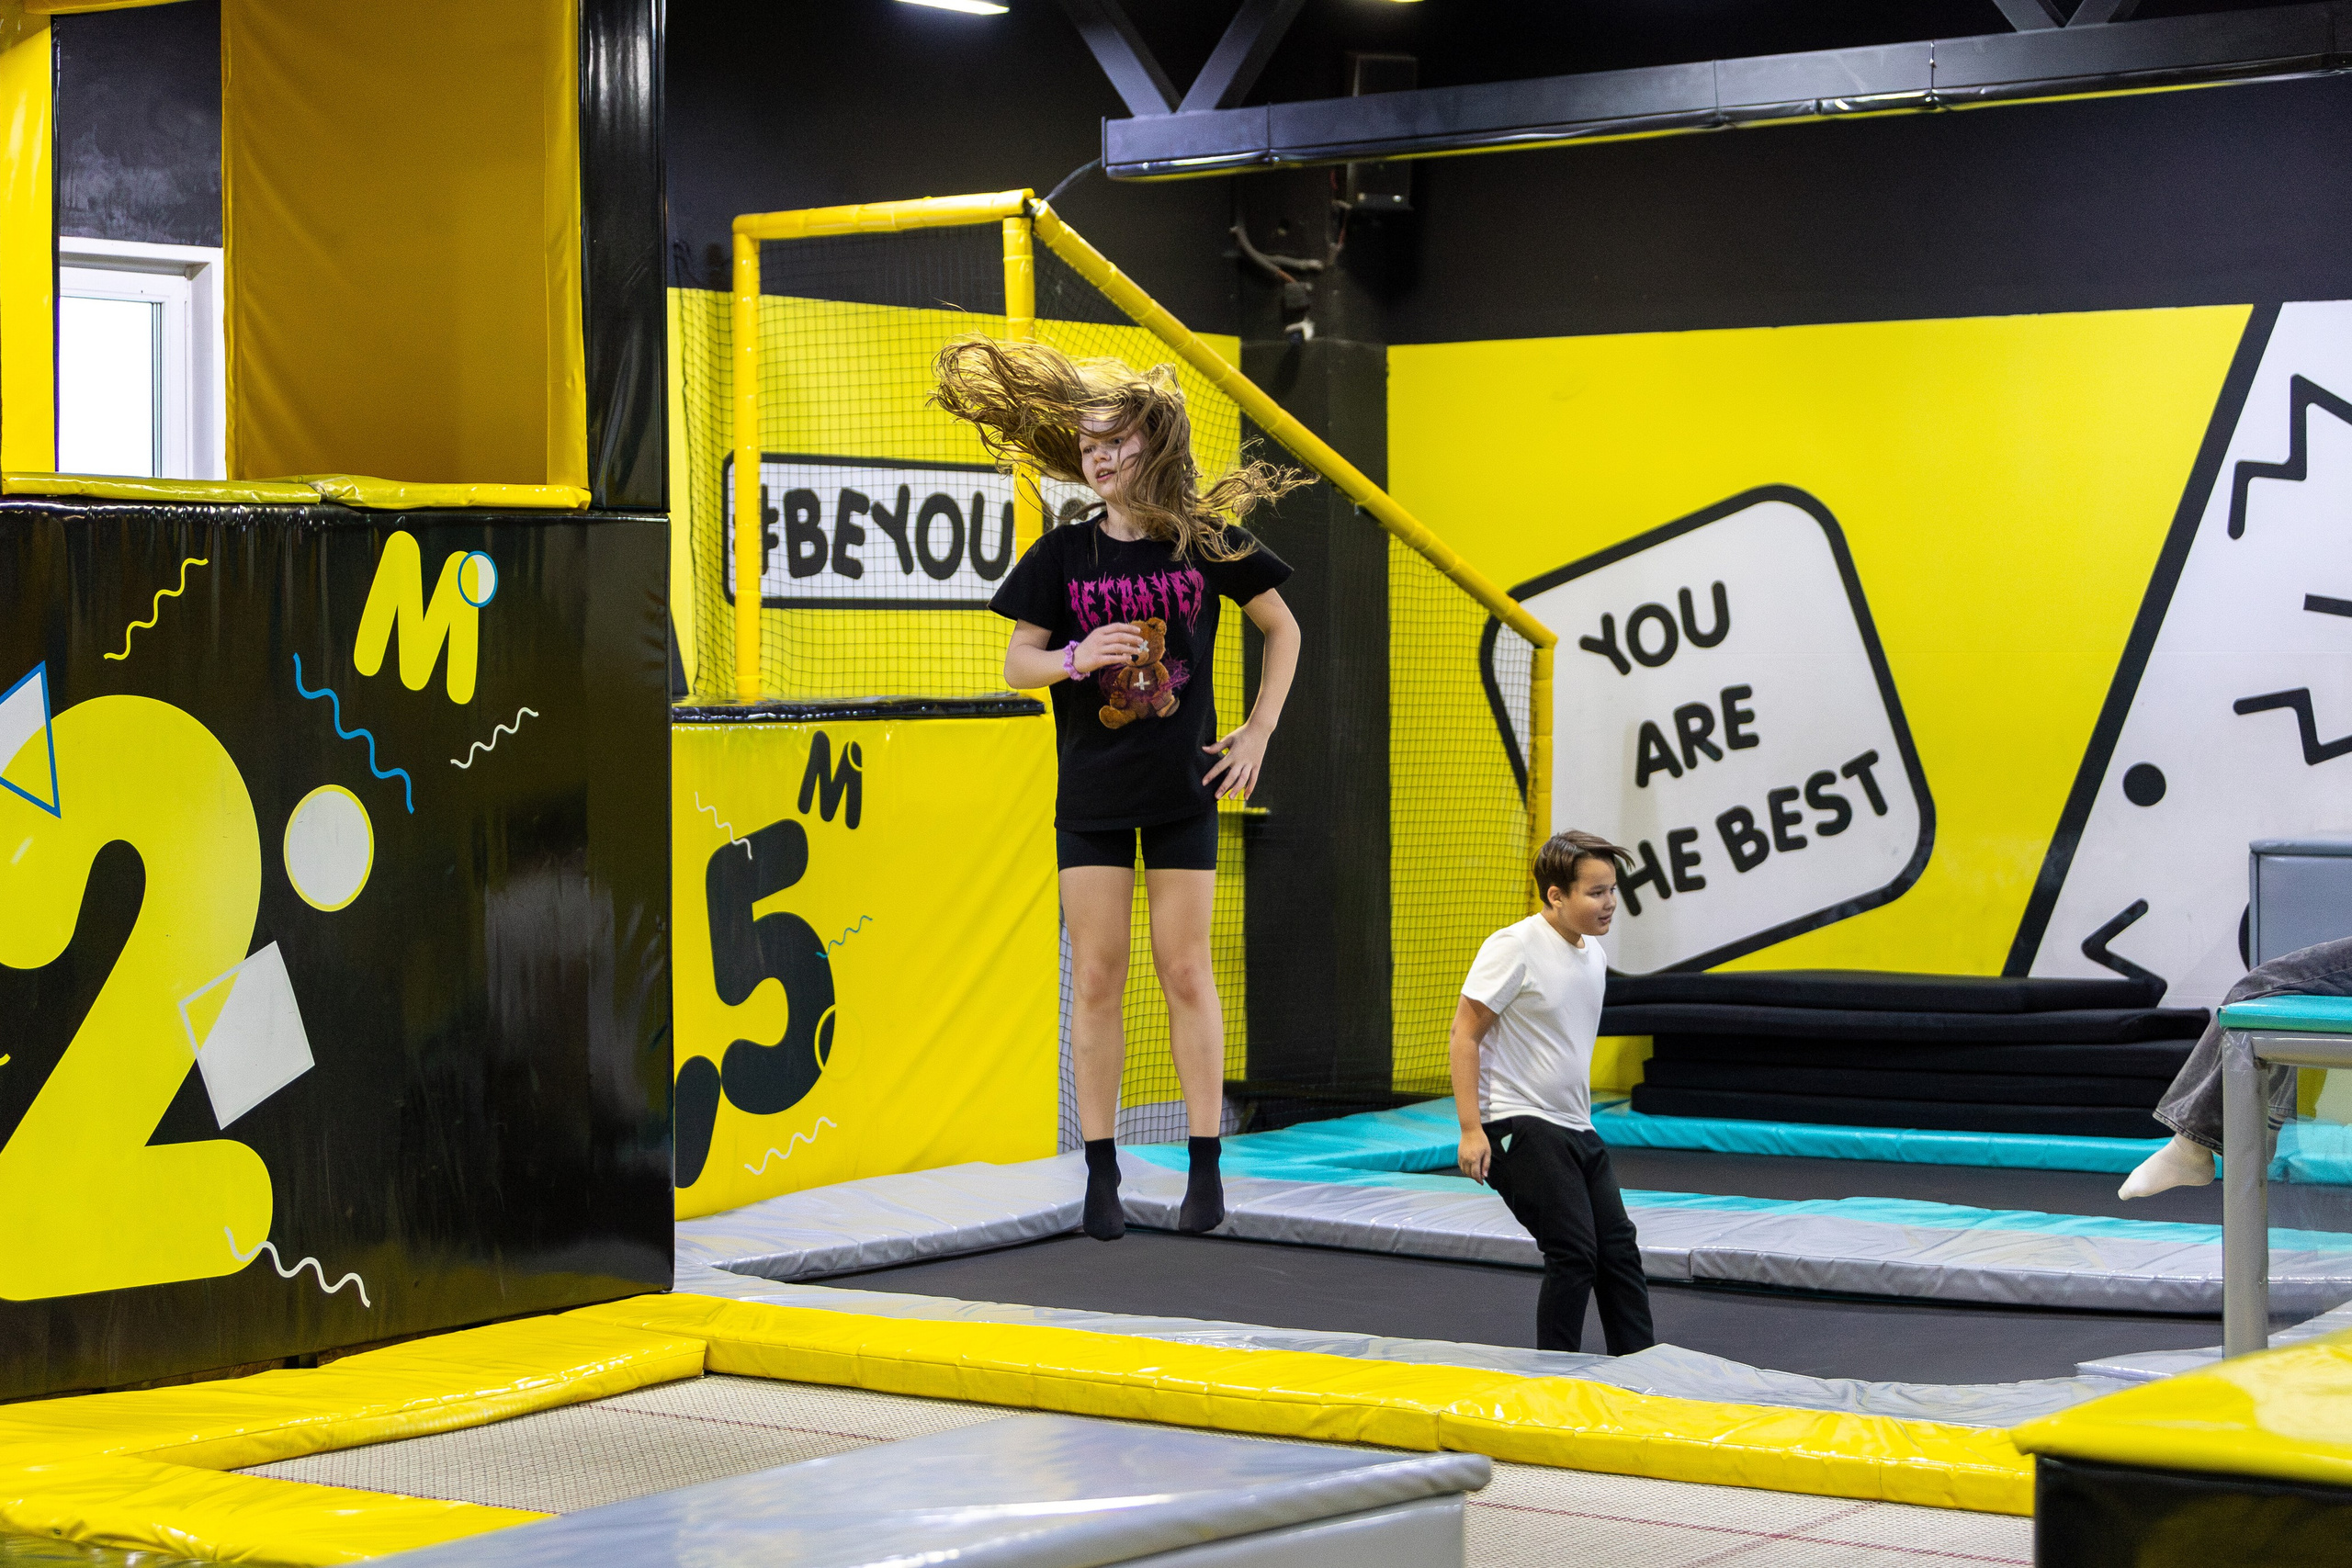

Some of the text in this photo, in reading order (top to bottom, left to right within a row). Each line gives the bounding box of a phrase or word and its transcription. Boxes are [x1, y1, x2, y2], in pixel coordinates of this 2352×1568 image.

[733, 483, 1089, 581] BEYOU
[1578, 580, 1731, 676] YOU
[1634, 683, 1760, 789] ARE
[1614, 749, 1889, 917] HE BEST
